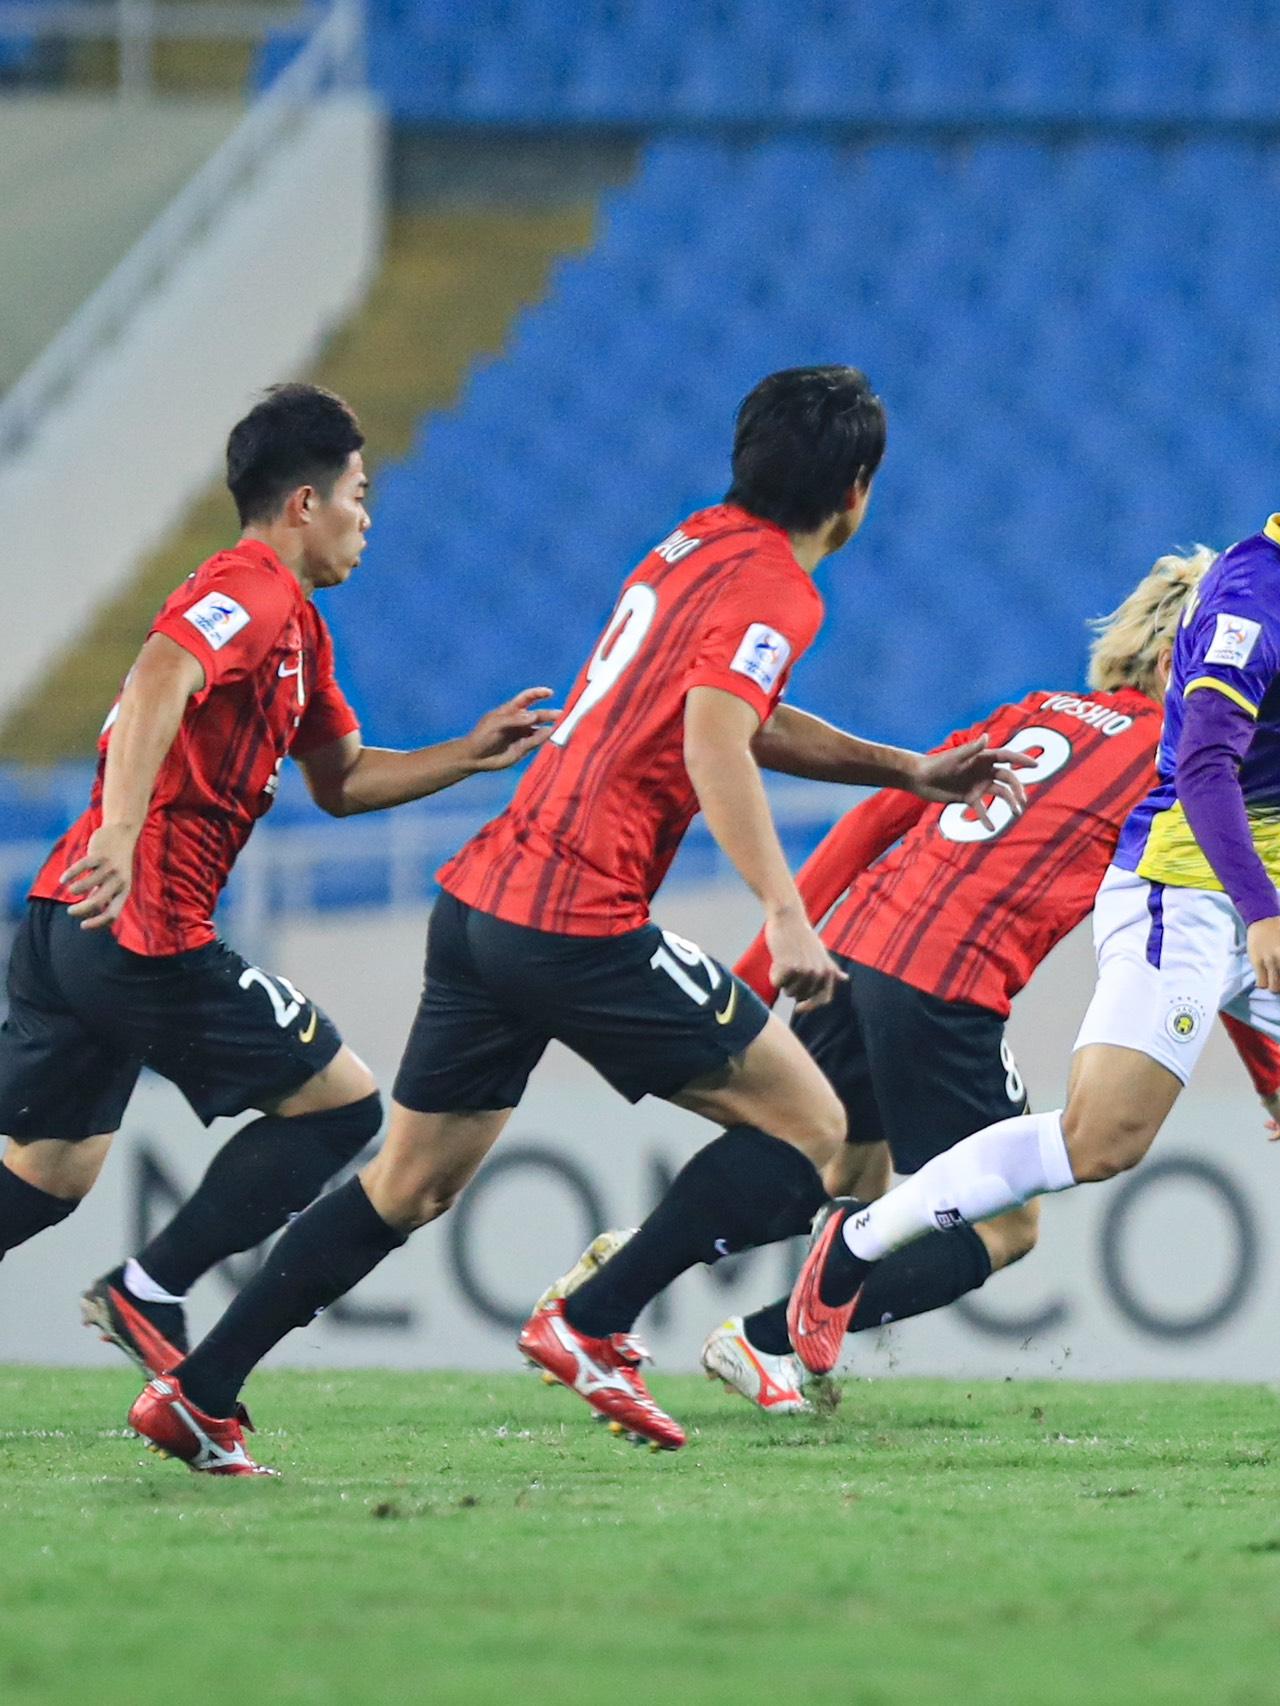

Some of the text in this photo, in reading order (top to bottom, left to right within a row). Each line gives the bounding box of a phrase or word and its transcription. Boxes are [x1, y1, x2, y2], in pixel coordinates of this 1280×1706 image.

[1039, 694, 1133, 737] YOSHIO
[649, 929, 721, 1006] 19
[1000, 1037, 1024, 1103] 8
